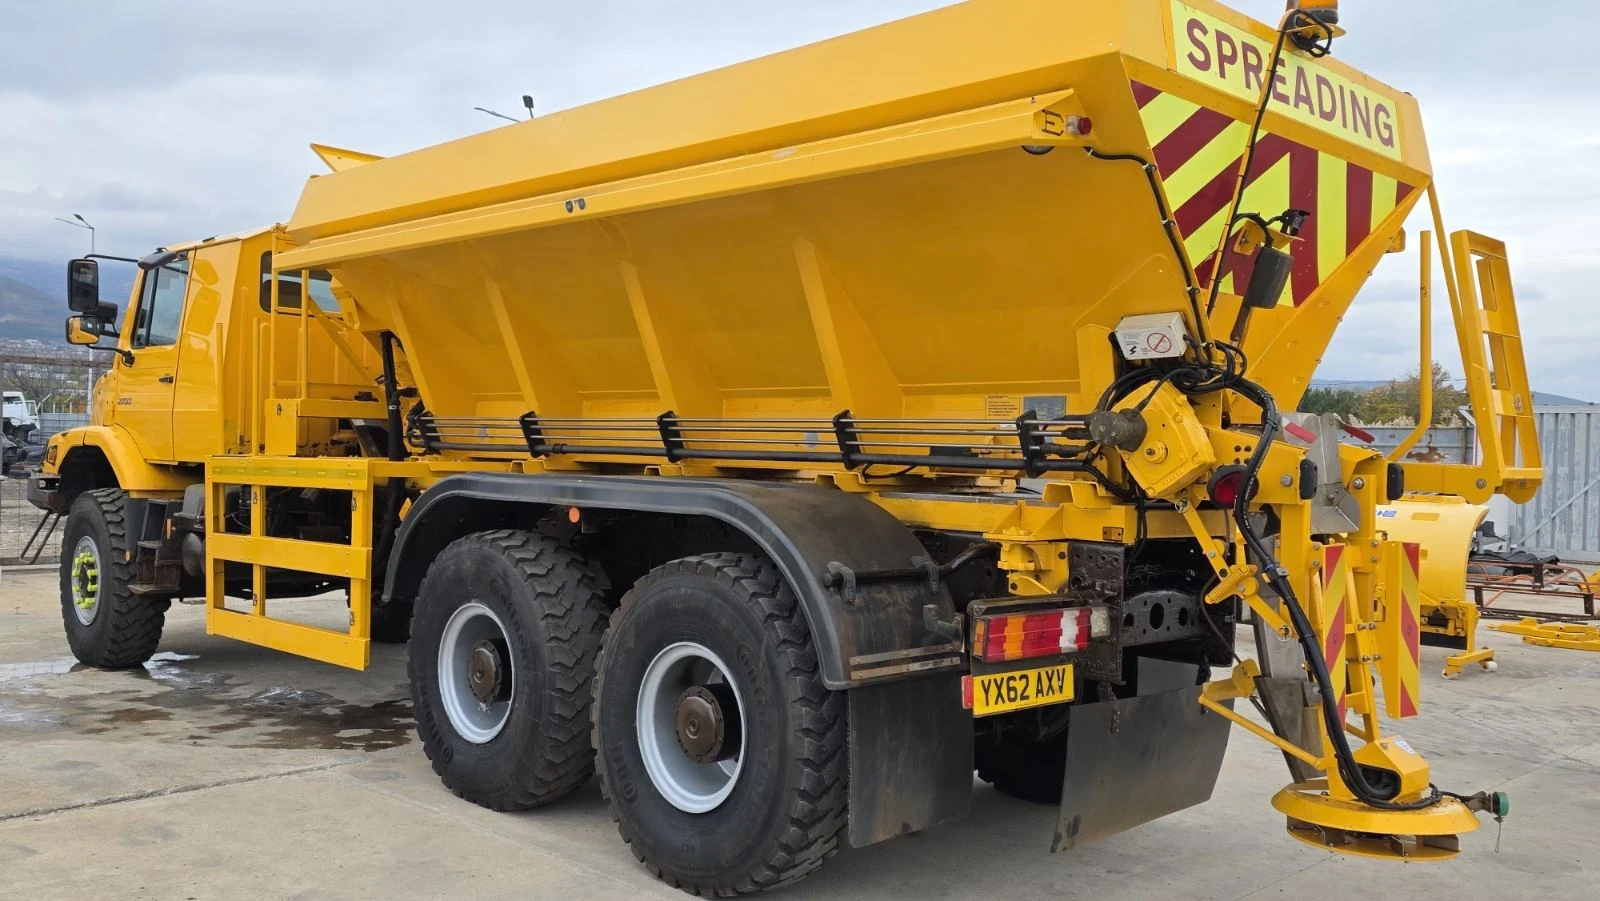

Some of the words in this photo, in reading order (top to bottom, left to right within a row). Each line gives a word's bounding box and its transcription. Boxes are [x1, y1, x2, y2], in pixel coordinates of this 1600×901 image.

[1186, 17, 1394, 148] SPREADING
[981, 674, 1029, 707] YX62
[1035, 668, 1066, 699] AXV
